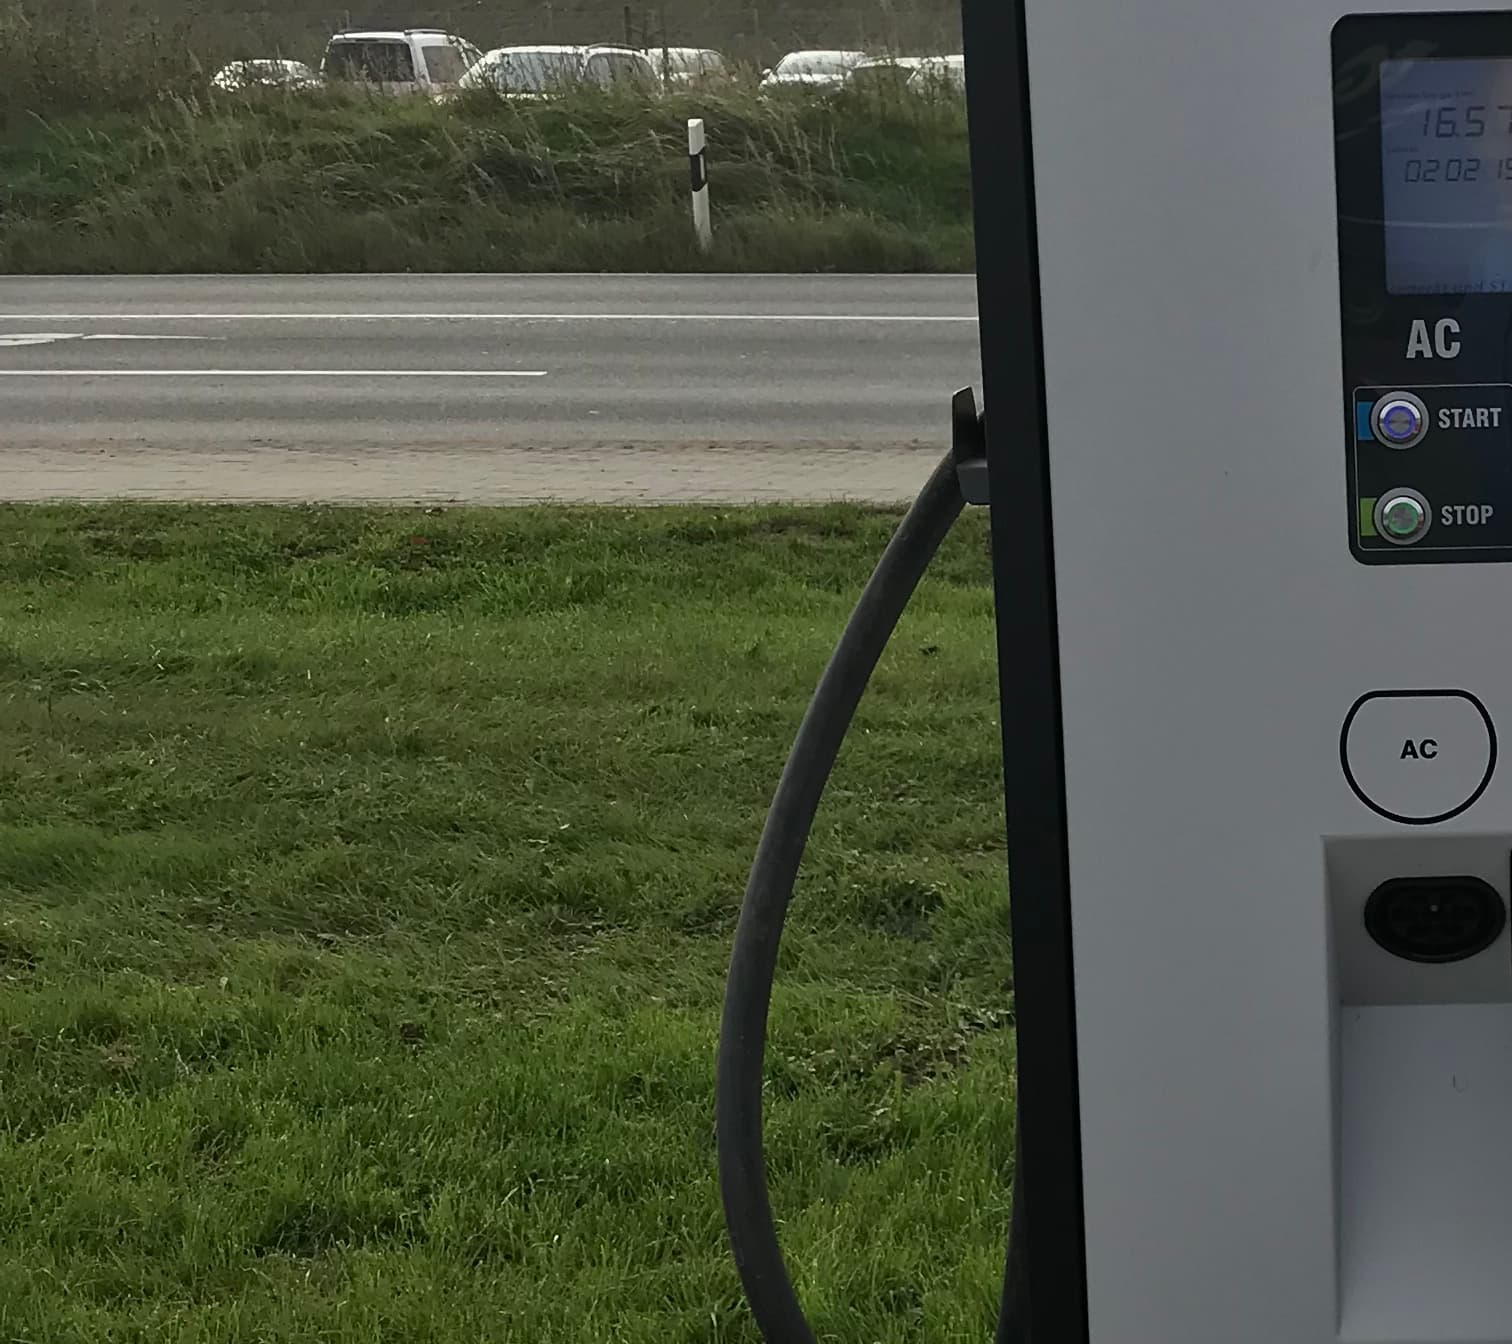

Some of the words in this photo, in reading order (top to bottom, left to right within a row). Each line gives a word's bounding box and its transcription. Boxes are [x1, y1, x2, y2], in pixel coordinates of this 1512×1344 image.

[1405, 317, 1462, 359] AC
[1437, 406, 1502, 430] START
[1440, 504, 1494, 526] STOP
[1399, 738, 1438, 760] AC
